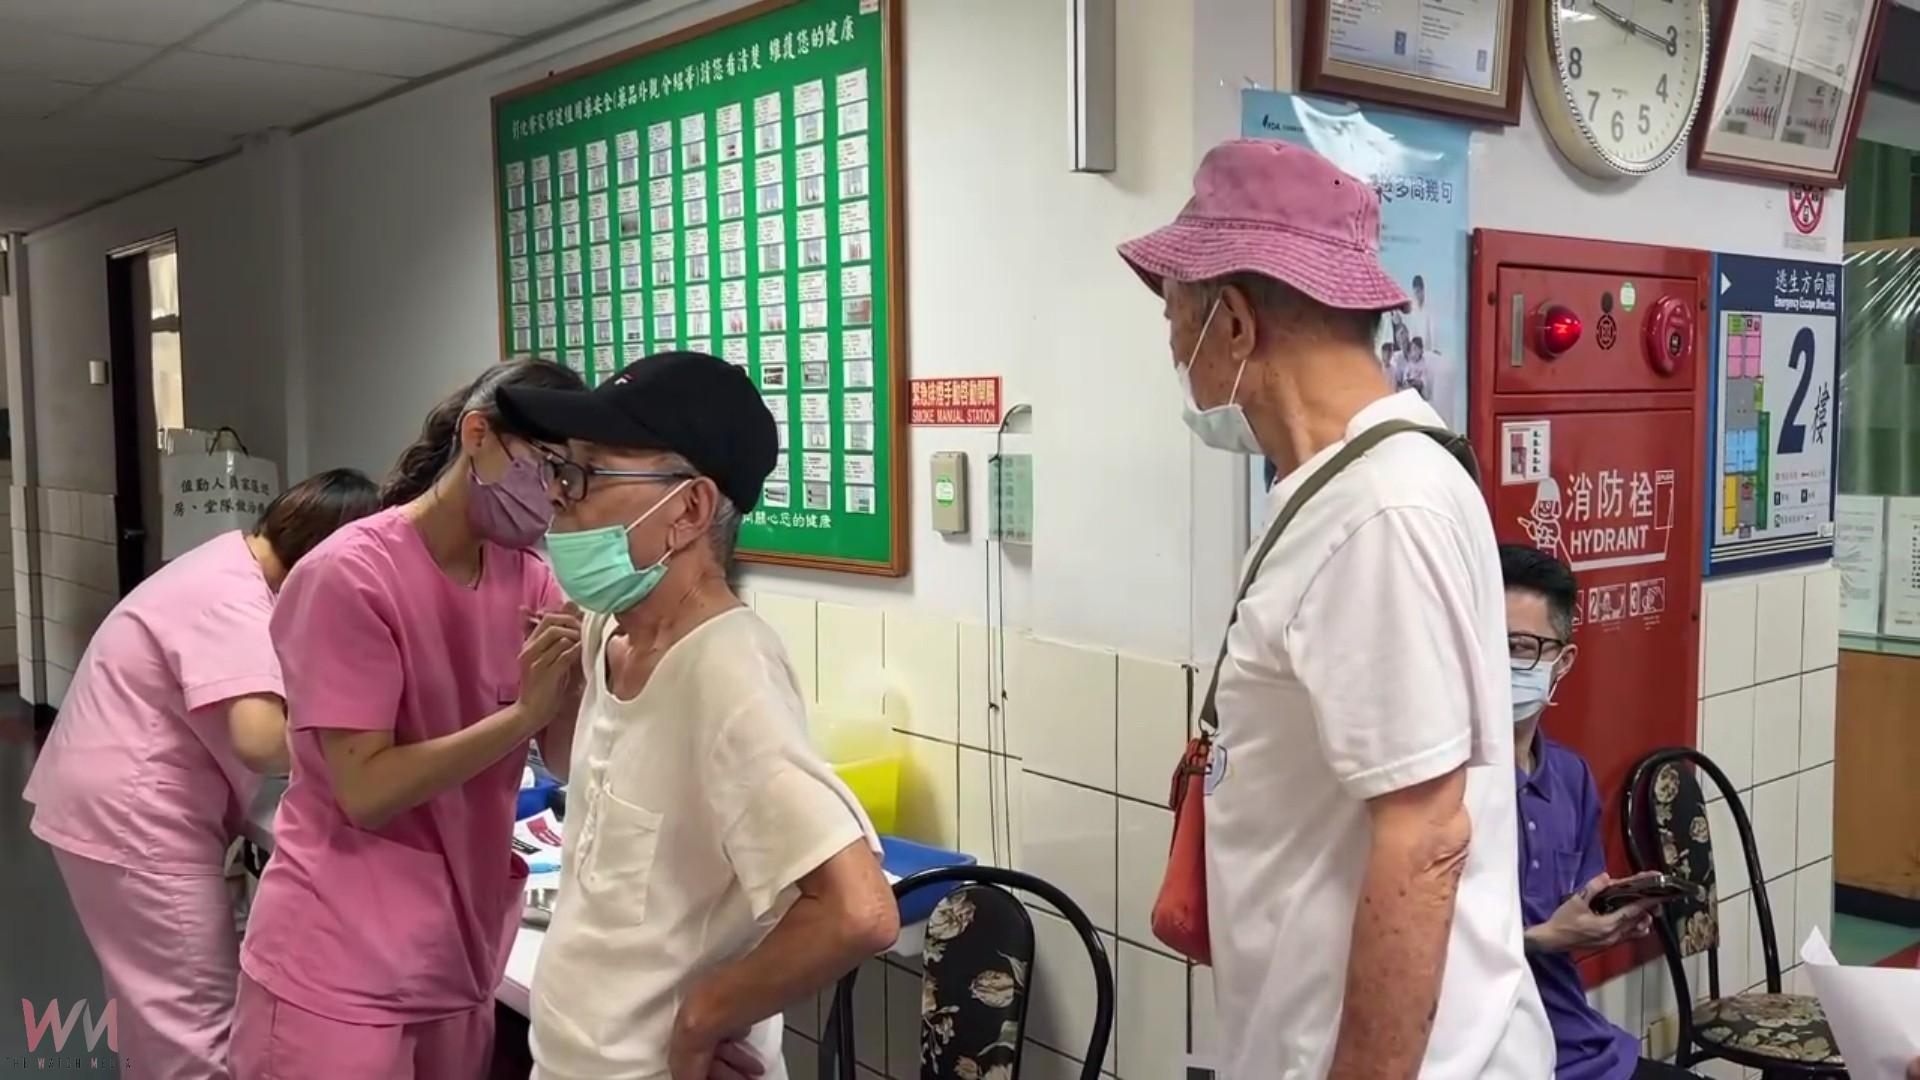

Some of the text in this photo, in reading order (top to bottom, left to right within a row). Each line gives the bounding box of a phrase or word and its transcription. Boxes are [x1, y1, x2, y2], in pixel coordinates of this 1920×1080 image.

[1568, 47, 1582, 79] 8
[1656, 73, 1668, 103] 4
[1587, 89, 1600, 121] 7
[1638, 103, 1650, 135] 5
[1611, 110, 1624, 142] 6
[1776, 269, 1836, 296] 逃生方向圖
[936, 408, 965, 423] MANUAL
[967, 407, 996, 423] STATION
[1565, 468, 1654, 522] 消防栓
[1570, 524, 1650, 555] HYDRANT
